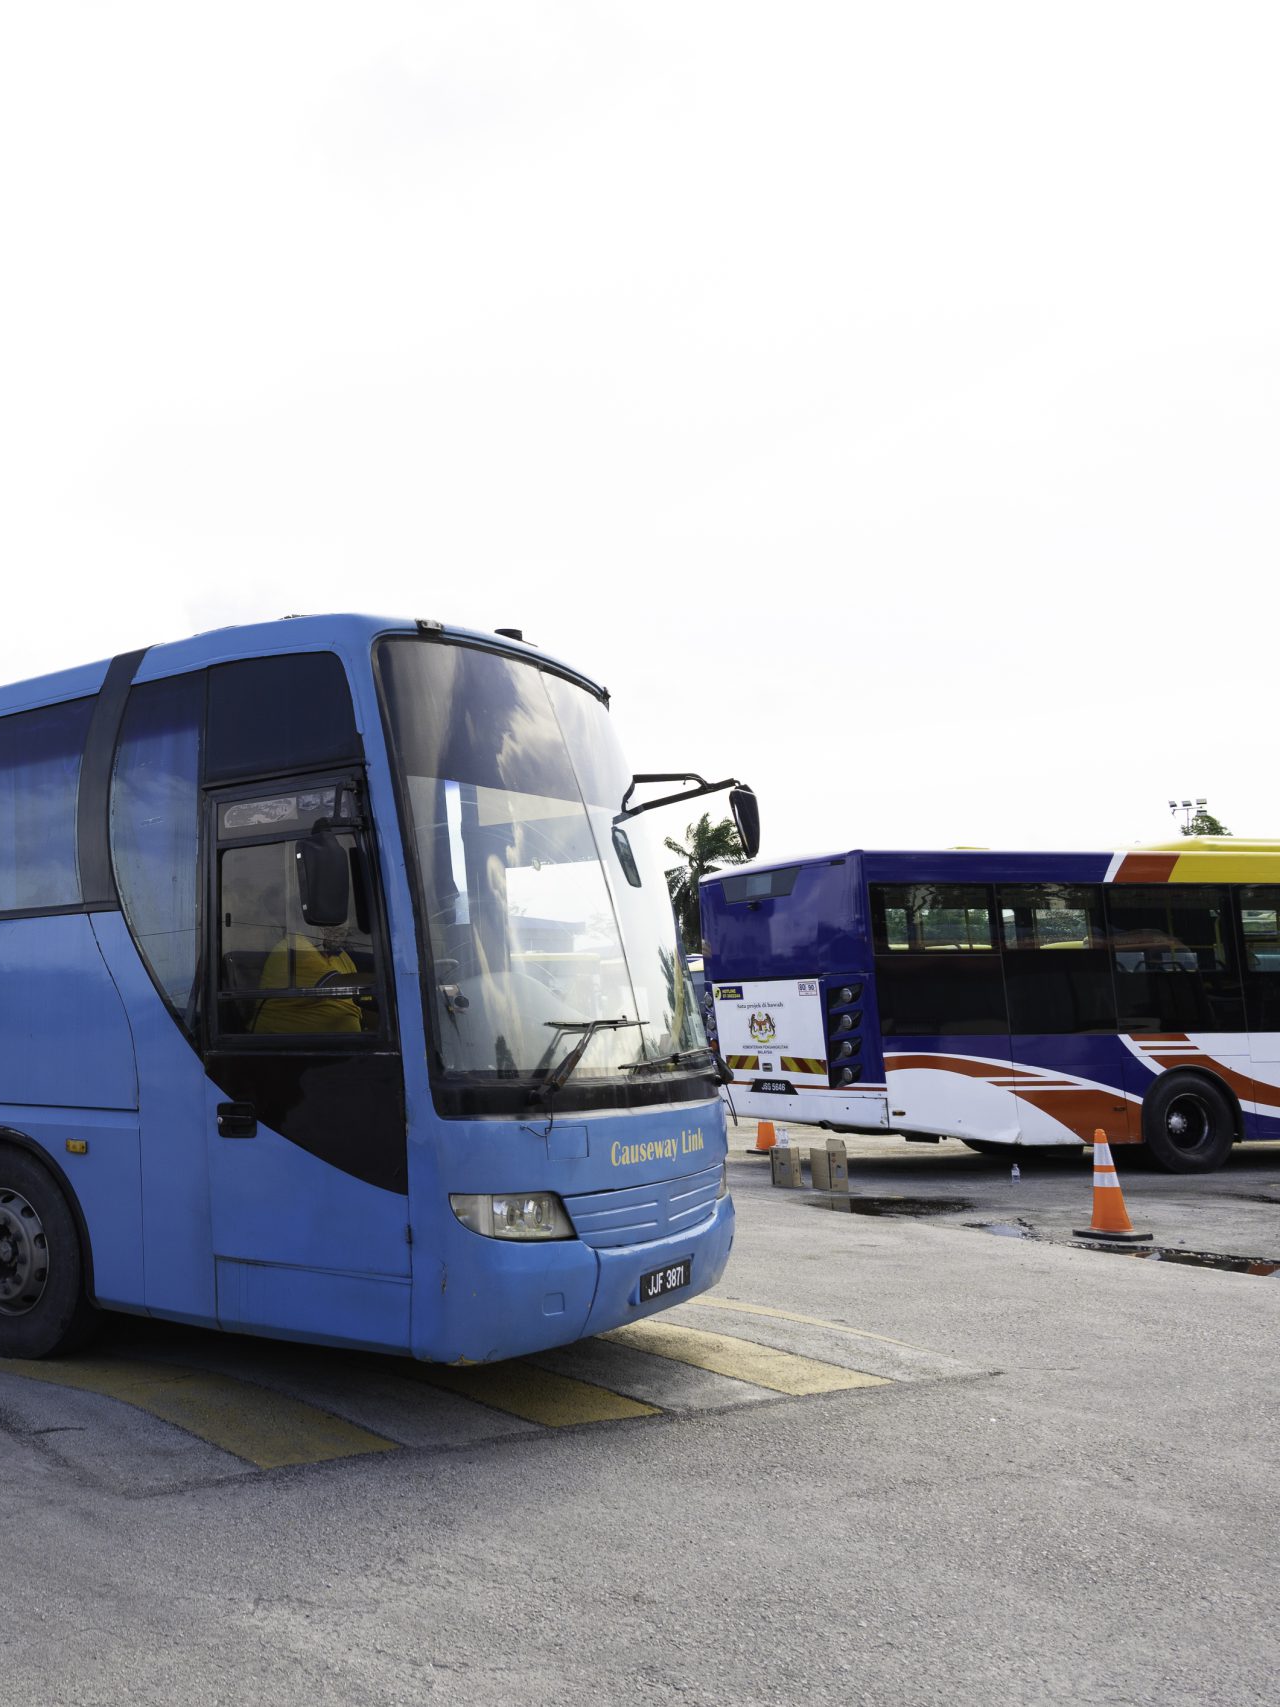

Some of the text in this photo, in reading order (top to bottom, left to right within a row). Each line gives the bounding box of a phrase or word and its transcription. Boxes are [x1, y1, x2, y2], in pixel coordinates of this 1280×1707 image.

[611, 1128, 704, 1167] Causeway Link
[648, 1264, 684, 1296] JJF 3871
